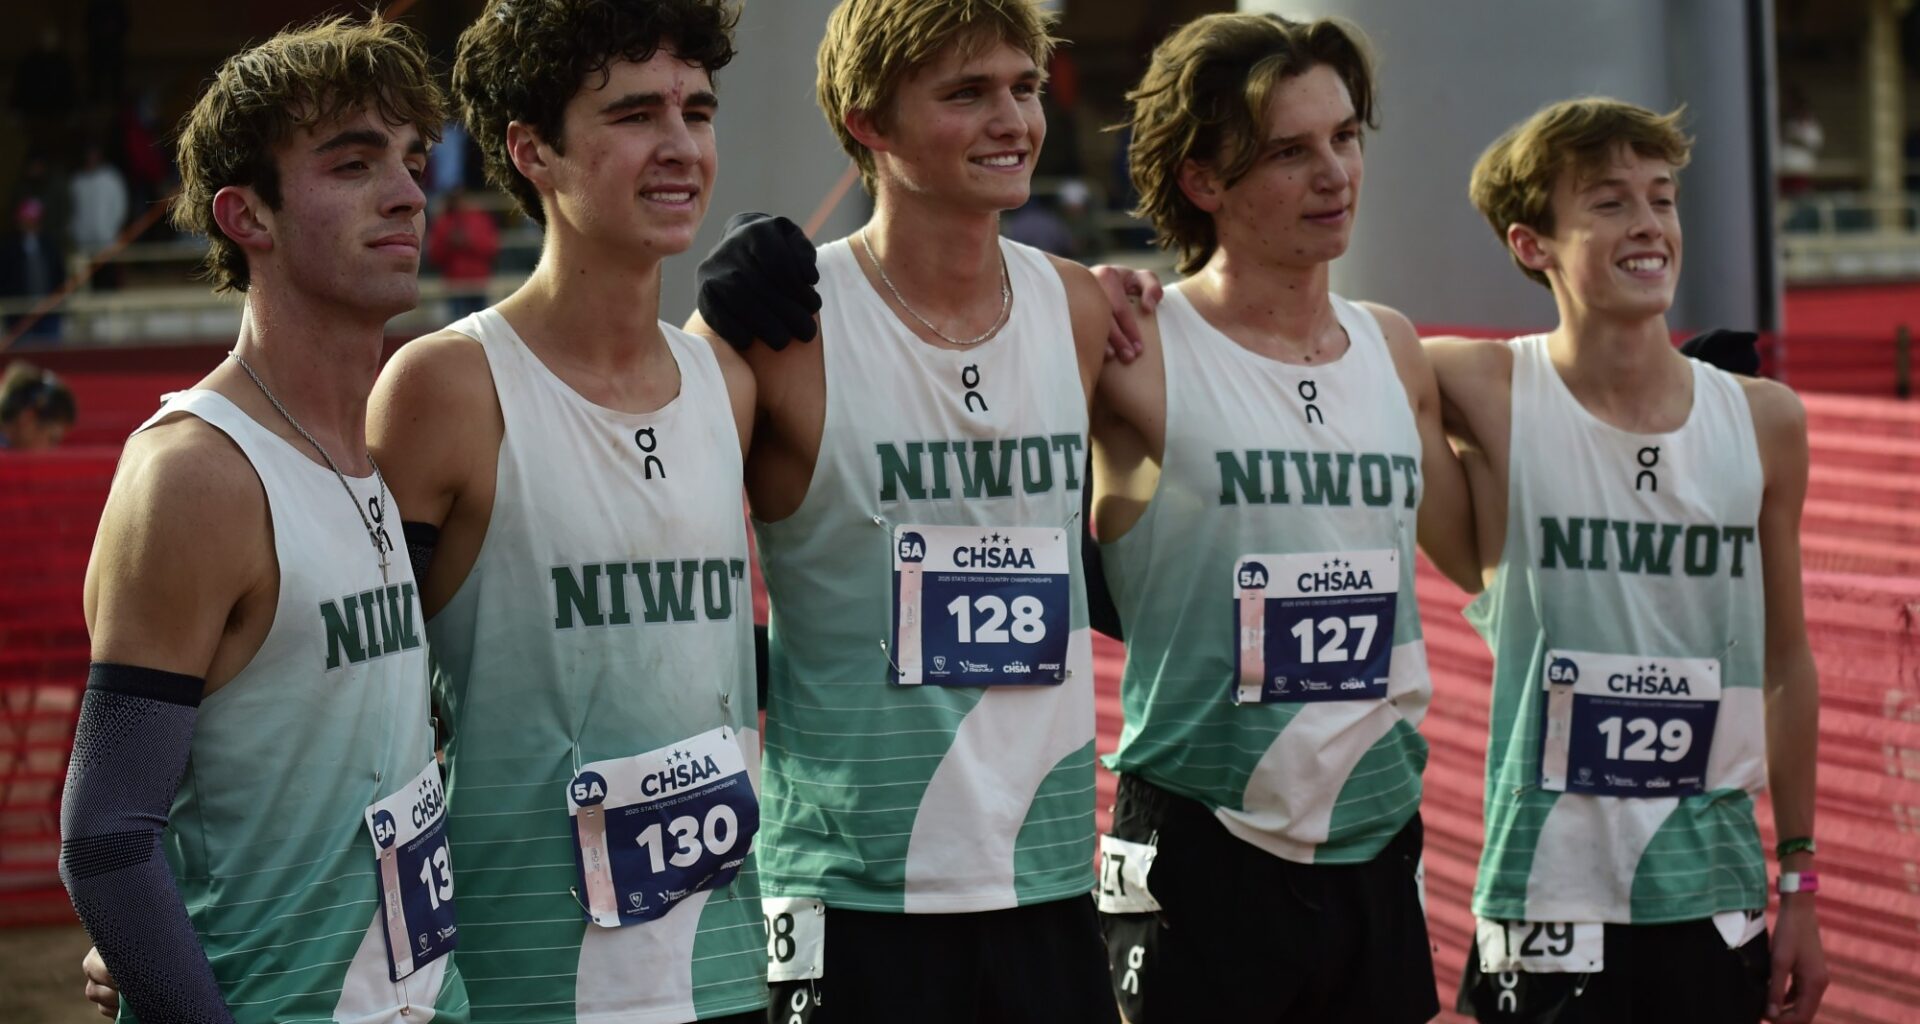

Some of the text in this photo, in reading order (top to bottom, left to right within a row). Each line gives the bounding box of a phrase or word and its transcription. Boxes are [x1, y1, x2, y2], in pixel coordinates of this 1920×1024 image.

[875, 432, 1083, 503] NIWOT
[1215, 449, 1418, 509] NIWOT
[900, 542, 923, 558] 5A
[953, 546, 1035, 569] CHSAA
[1540, 516, 1755, 578] NIWOT
[1240, 571, 1266, 587] 5A
[1297, 570, 1373, 593] CHSAA
[947, 595, 1046, 644] 128
[1290, 614, 1378, 664] 127
[1003, 664, 1031, 673] CHSAA
[1551, 666, 1576, 682] 5A
[1607, 674, 1691, 696] CHSAA
[1597, 716, 1693, 762] 129
[641, 755, 720, 797] CHSAA
[574, 781, 604, 801] 5A
[677, 791, 702, 803] COUNTRY
[375, 820, 396, 842] 5A
[635, 803, 739, 874] 130
[420, 836, 455, 911] 13
